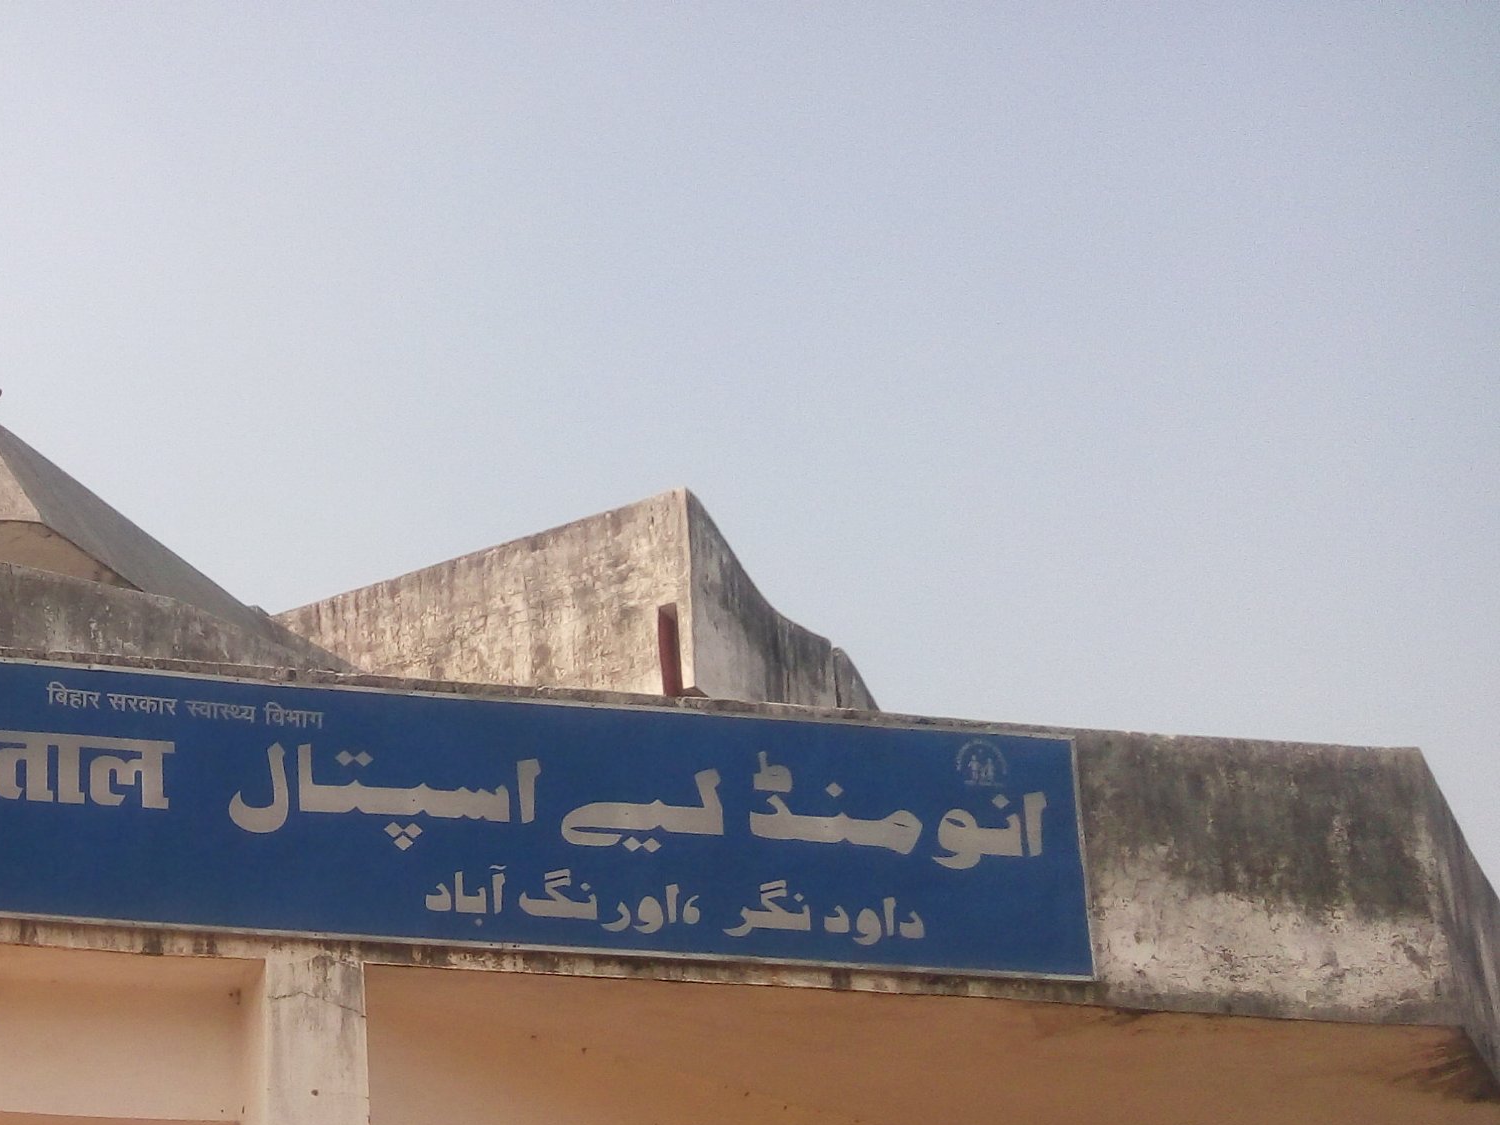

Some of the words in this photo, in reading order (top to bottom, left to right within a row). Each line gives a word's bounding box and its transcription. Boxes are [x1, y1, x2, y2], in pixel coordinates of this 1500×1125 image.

[46, 681, 100, 709] बिहार
[106, 692, 178, 716] सरकार
[185, 699, 257, 724] स्वास्थ्य
[263, 701, 325, 730] विभाग
[228, 741, 541, 851] اسپتال
